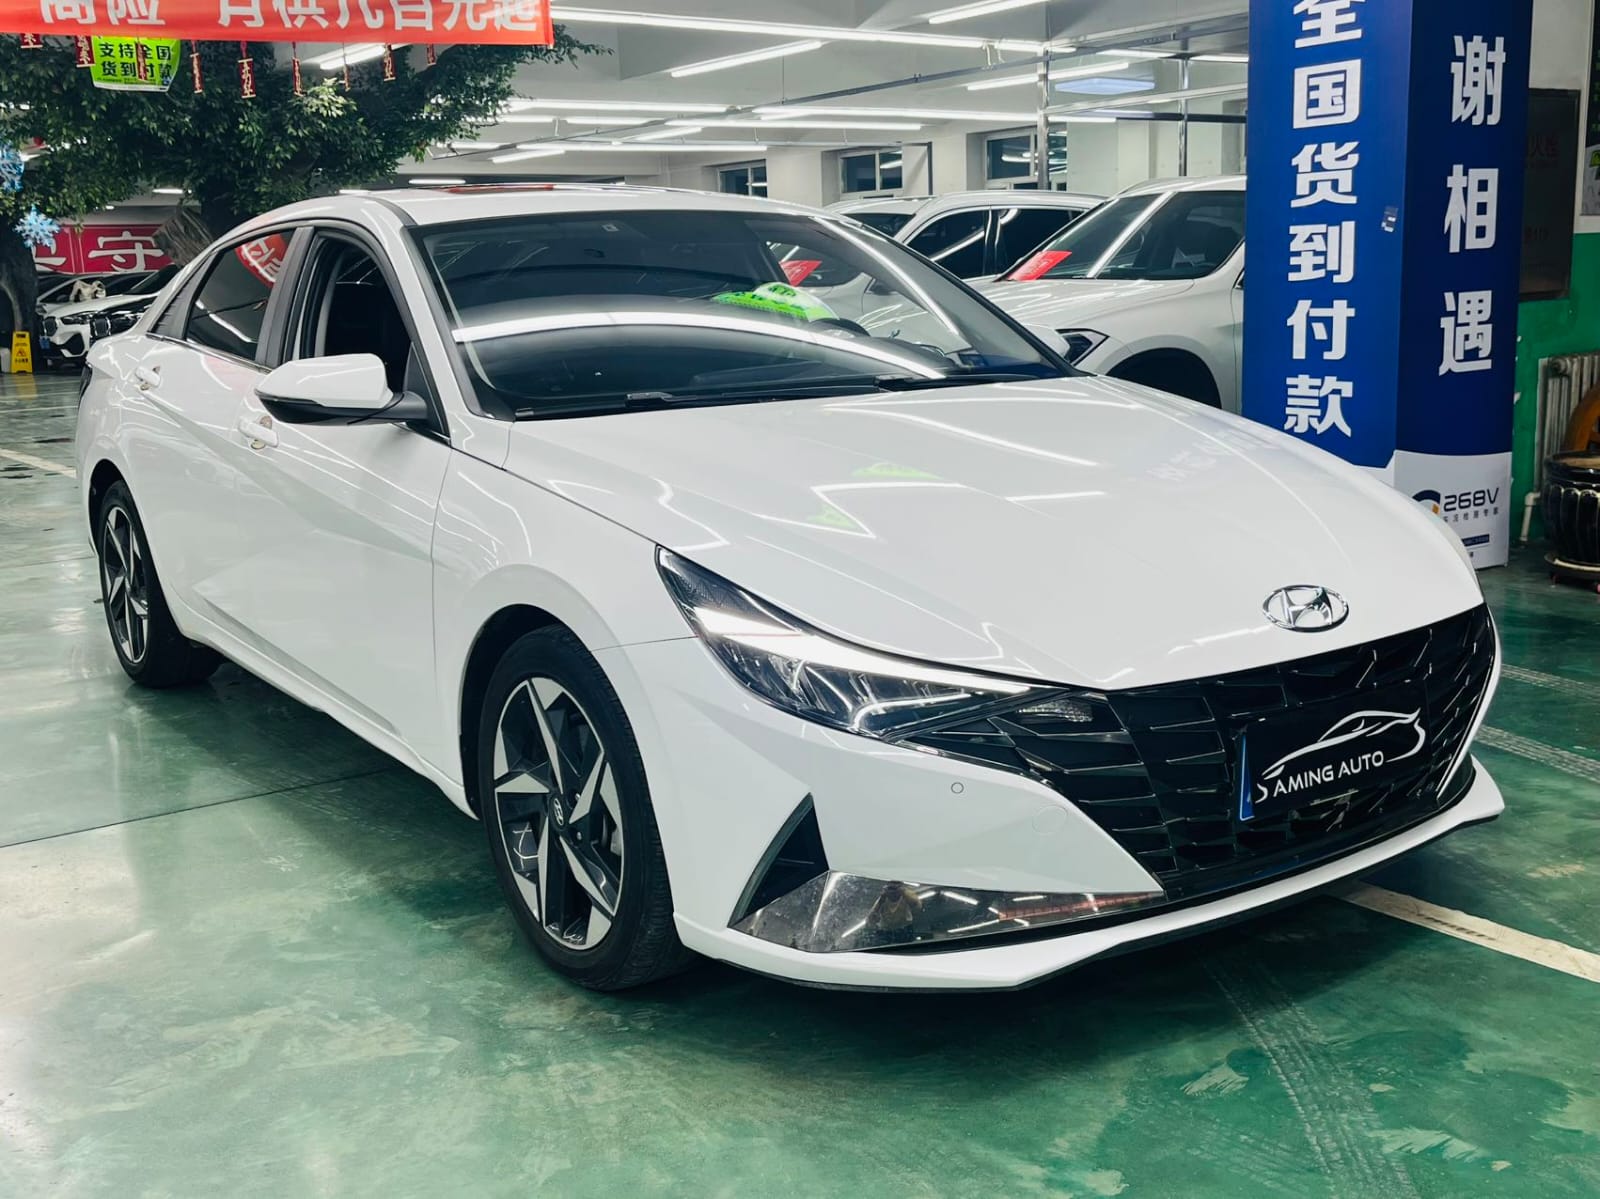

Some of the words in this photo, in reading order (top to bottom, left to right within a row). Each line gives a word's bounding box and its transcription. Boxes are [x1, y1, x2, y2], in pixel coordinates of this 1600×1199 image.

[1282, 0, 1364, 438] 全国货到付款
[1437, 33, 1507, 377] 谢相遇
[1443, 487, 1500, 512] 268V
[1337, 750, 1385, 779] AUTO
